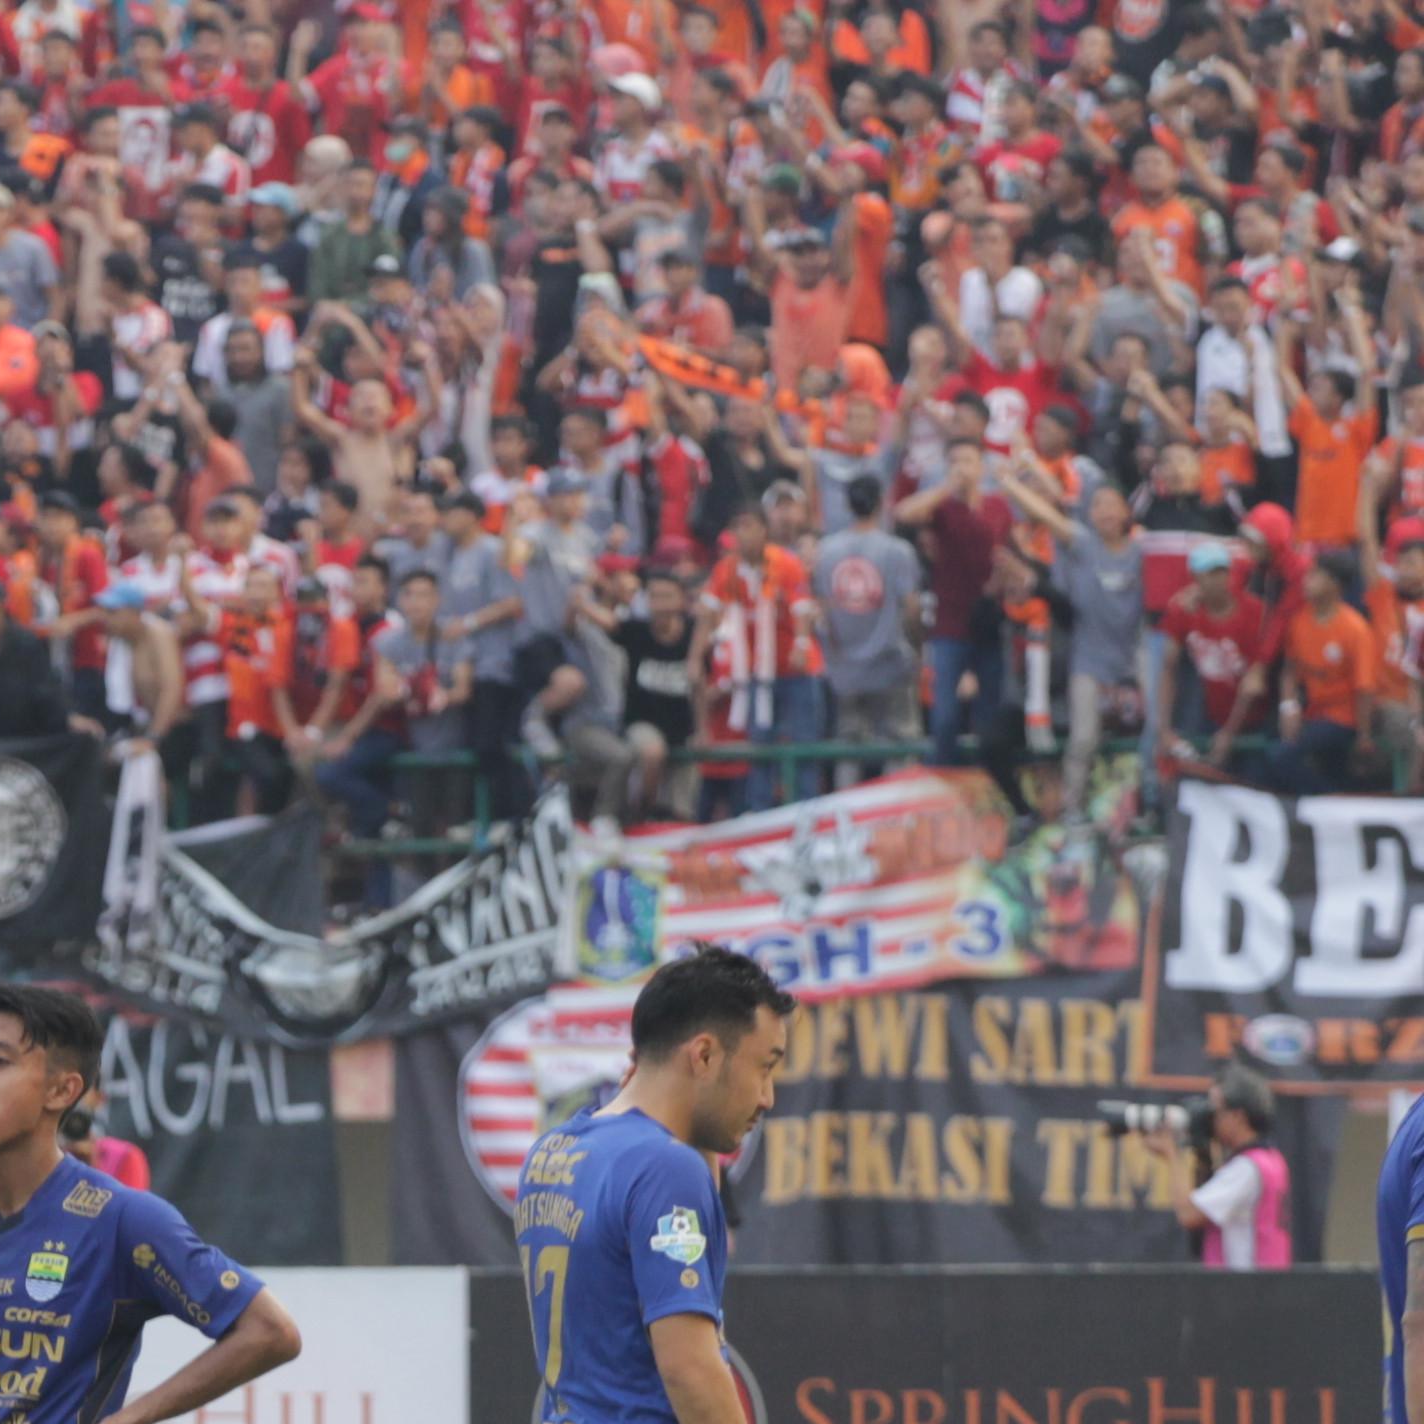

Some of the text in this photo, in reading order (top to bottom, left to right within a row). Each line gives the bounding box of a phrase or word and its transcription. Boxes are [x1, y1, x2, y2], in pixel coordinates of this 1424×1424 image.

[774, 992, 950, 1084] DEWI
[762, 1109, 1016, 1207] BEKASI
[521, 1245, 570, 1389] 17
